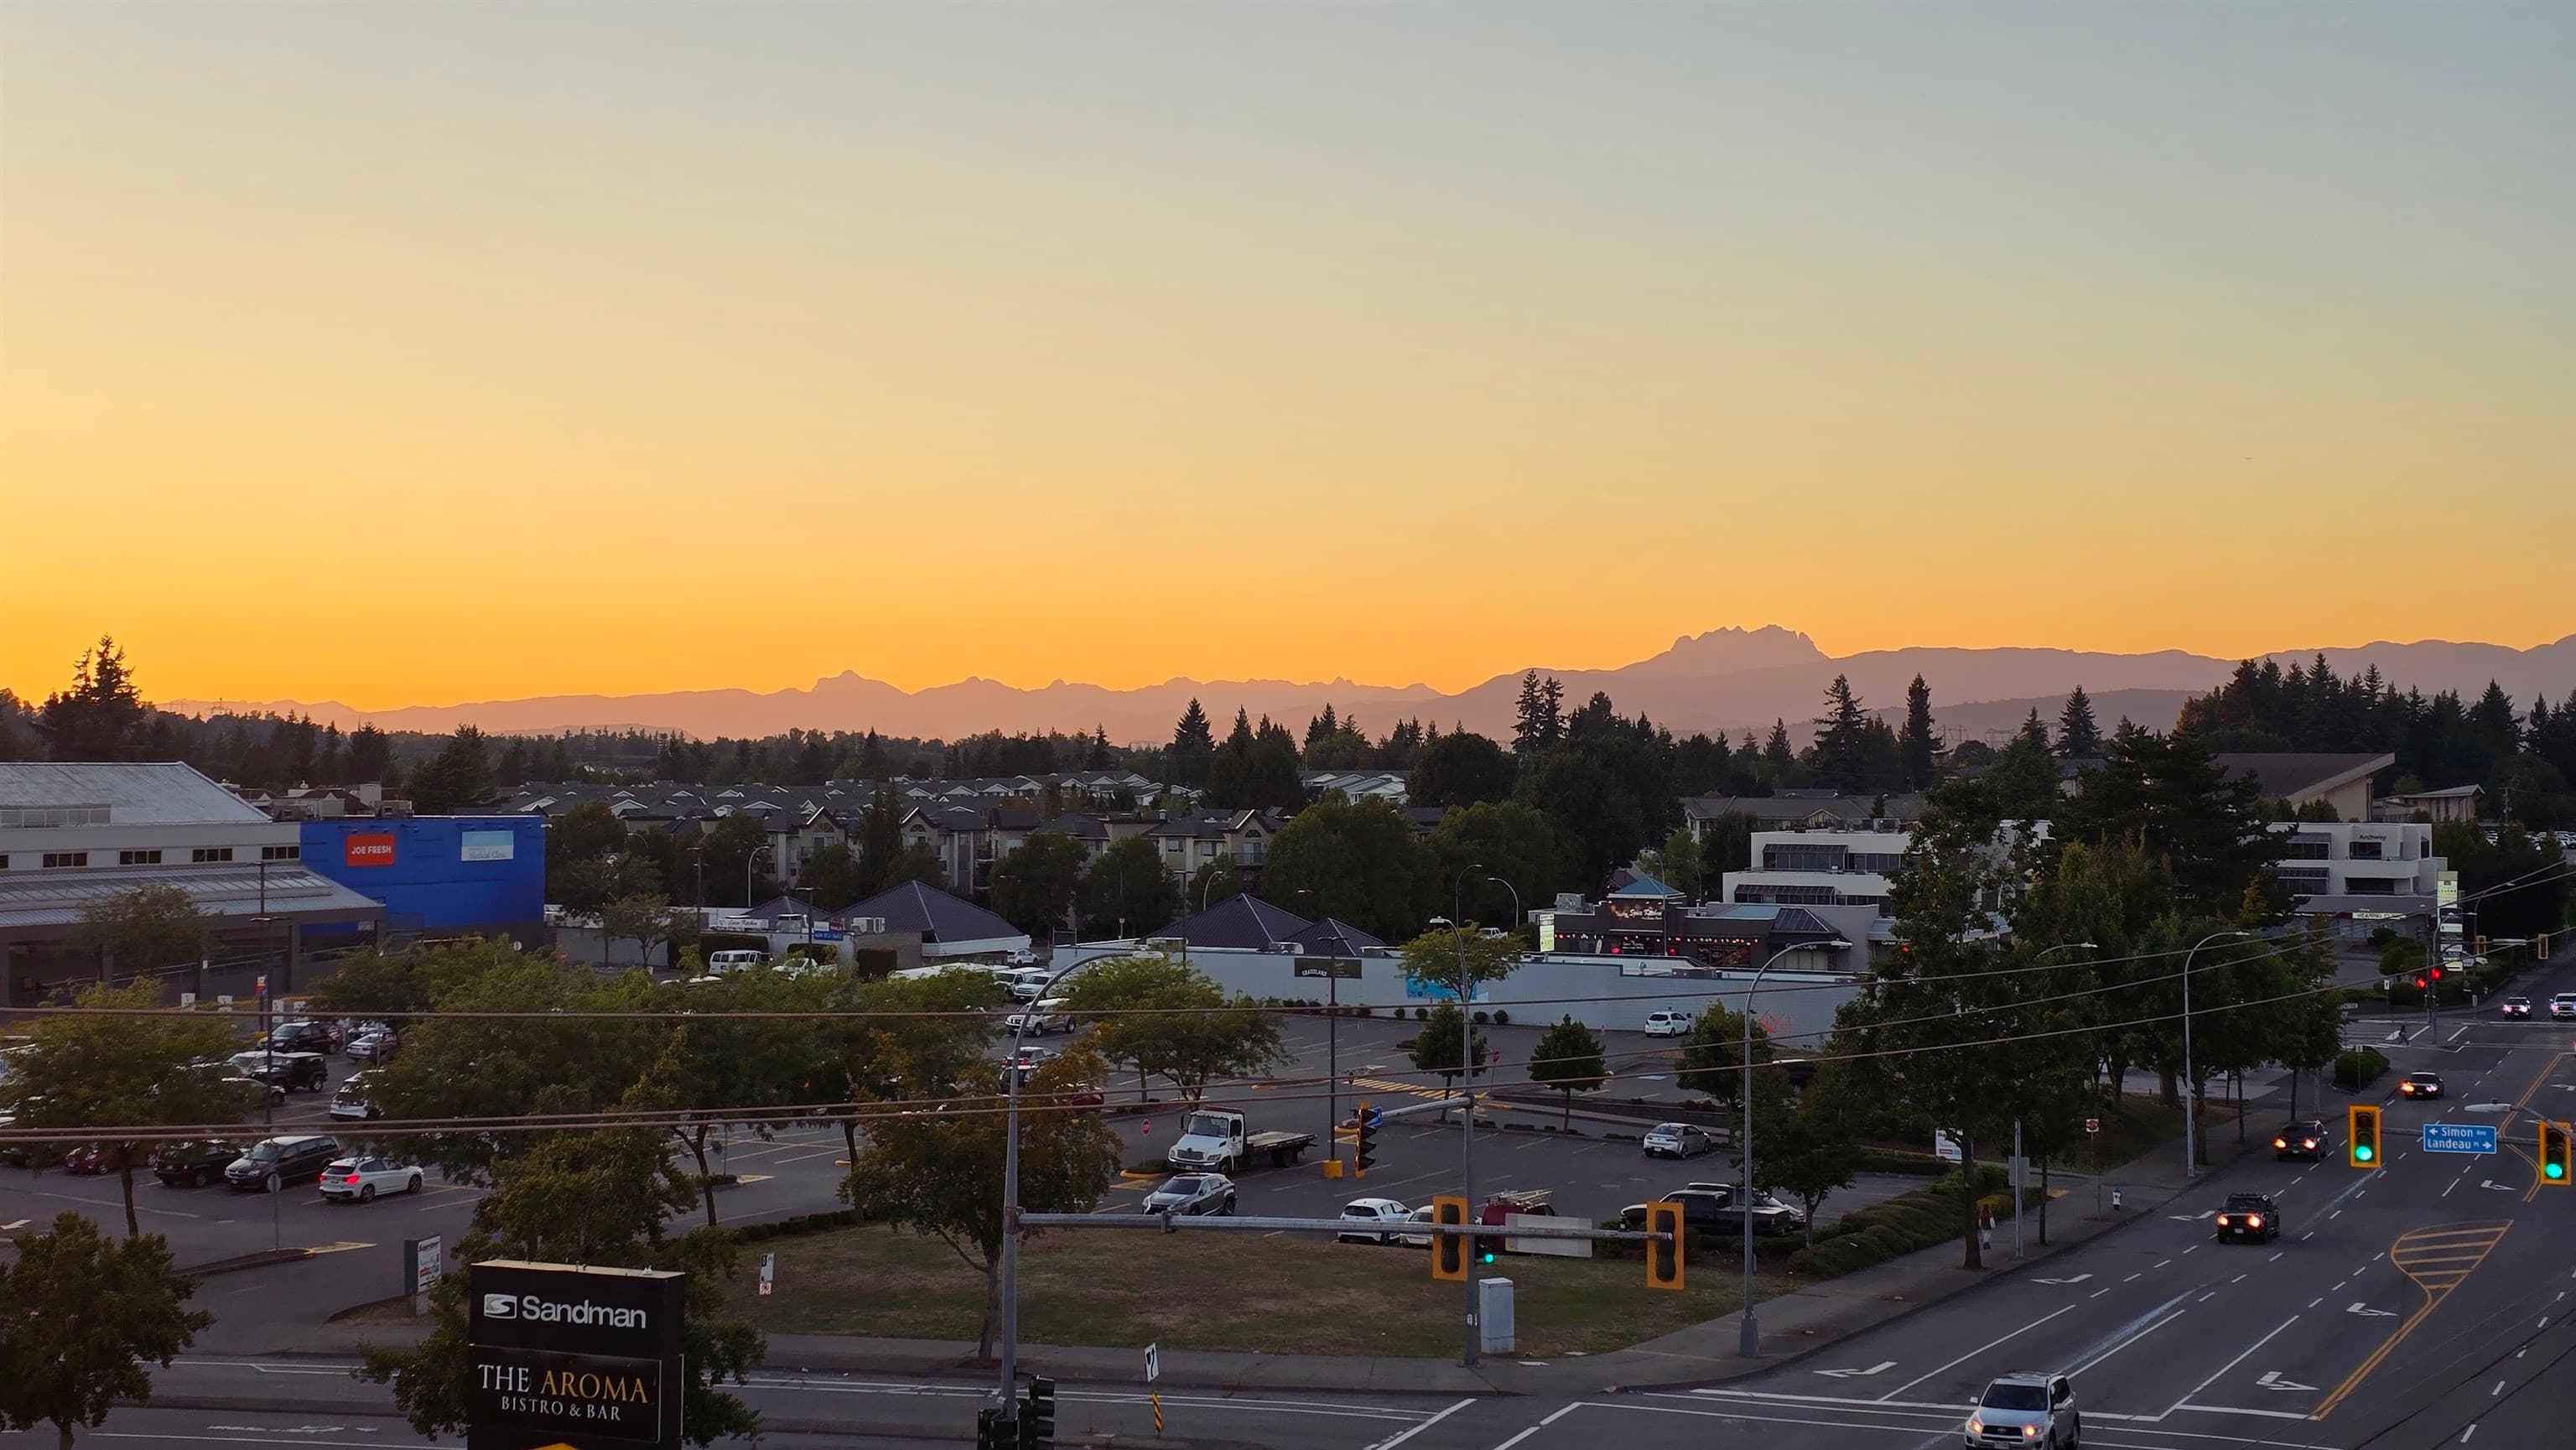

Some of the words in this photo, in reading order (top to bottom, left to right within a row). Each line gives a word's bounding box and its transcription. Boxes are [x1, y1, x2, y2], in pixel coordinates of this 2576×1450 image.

[2359, 834, 2386, 842] Archway
[351, 845, 366, 855] JOE
[367, 845, 392, 854] FRESH
[2441, 1126, 2474, 1138] Simon
[2428, 1138, 2471, 1149] Landeau
[522, 1295, 646, 1329] Sandman
[478, 1364, 531, 1393] THE
[540, 1369, 648, 1404] AROMA
[501, 1395, 564, 1416] BISTRO
[569, 1403, 582, 1417] &
[587, 1404, 621, 1421] BAR
